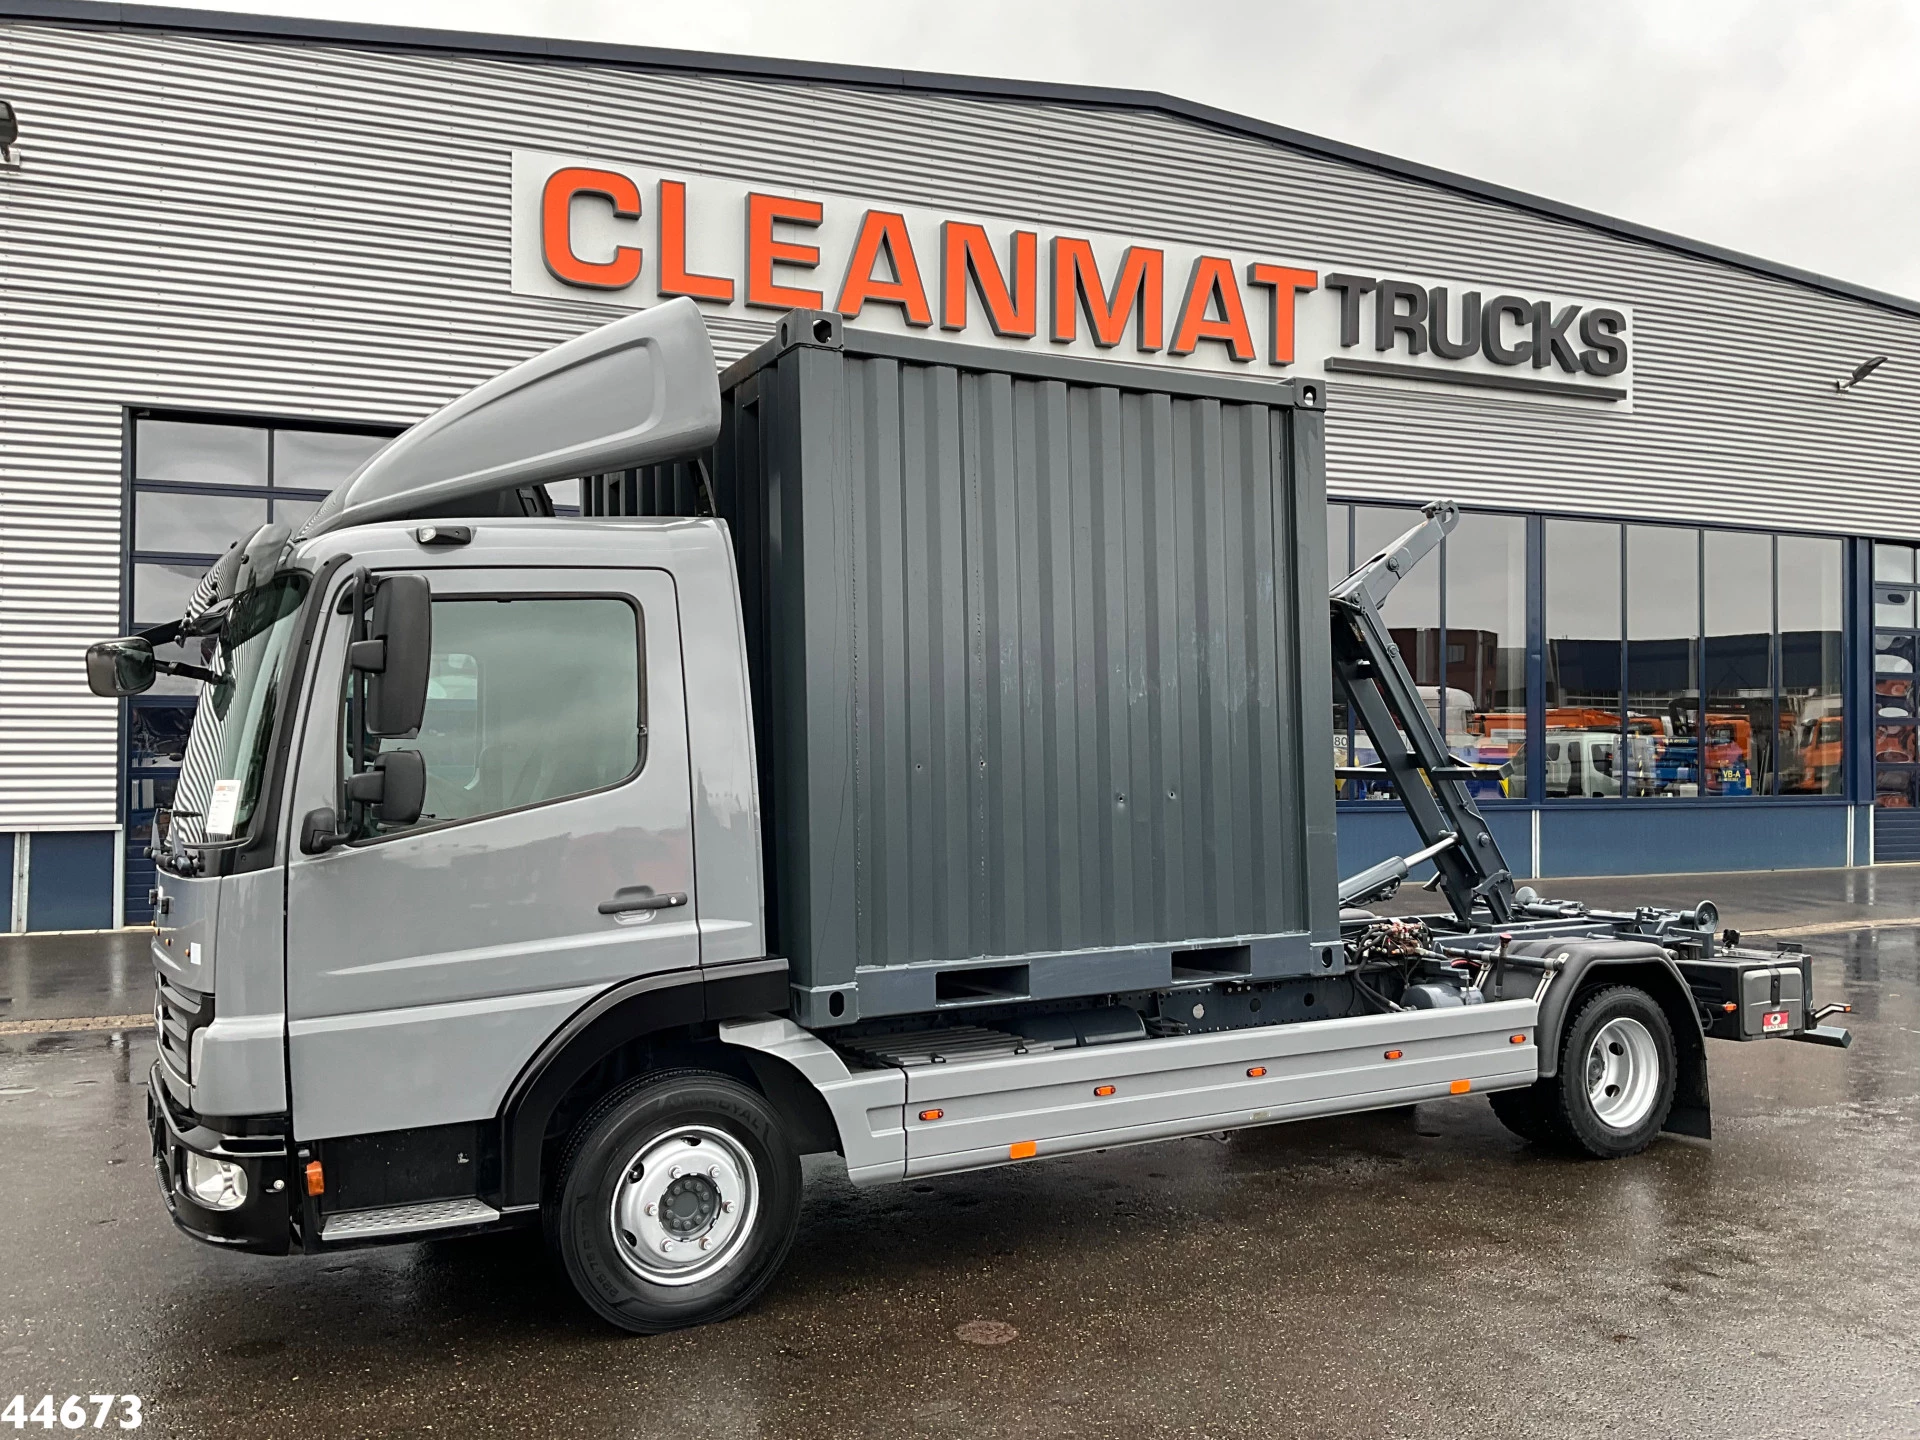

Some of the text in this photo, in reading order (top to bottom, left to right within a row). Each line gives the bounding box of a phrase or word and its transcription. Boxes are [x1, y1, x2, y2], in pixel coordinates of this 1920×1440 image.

[541, 166, 1629, 377] CLEANMAT TRUCKS
[1722, 770, 1741, 778] VB-A
